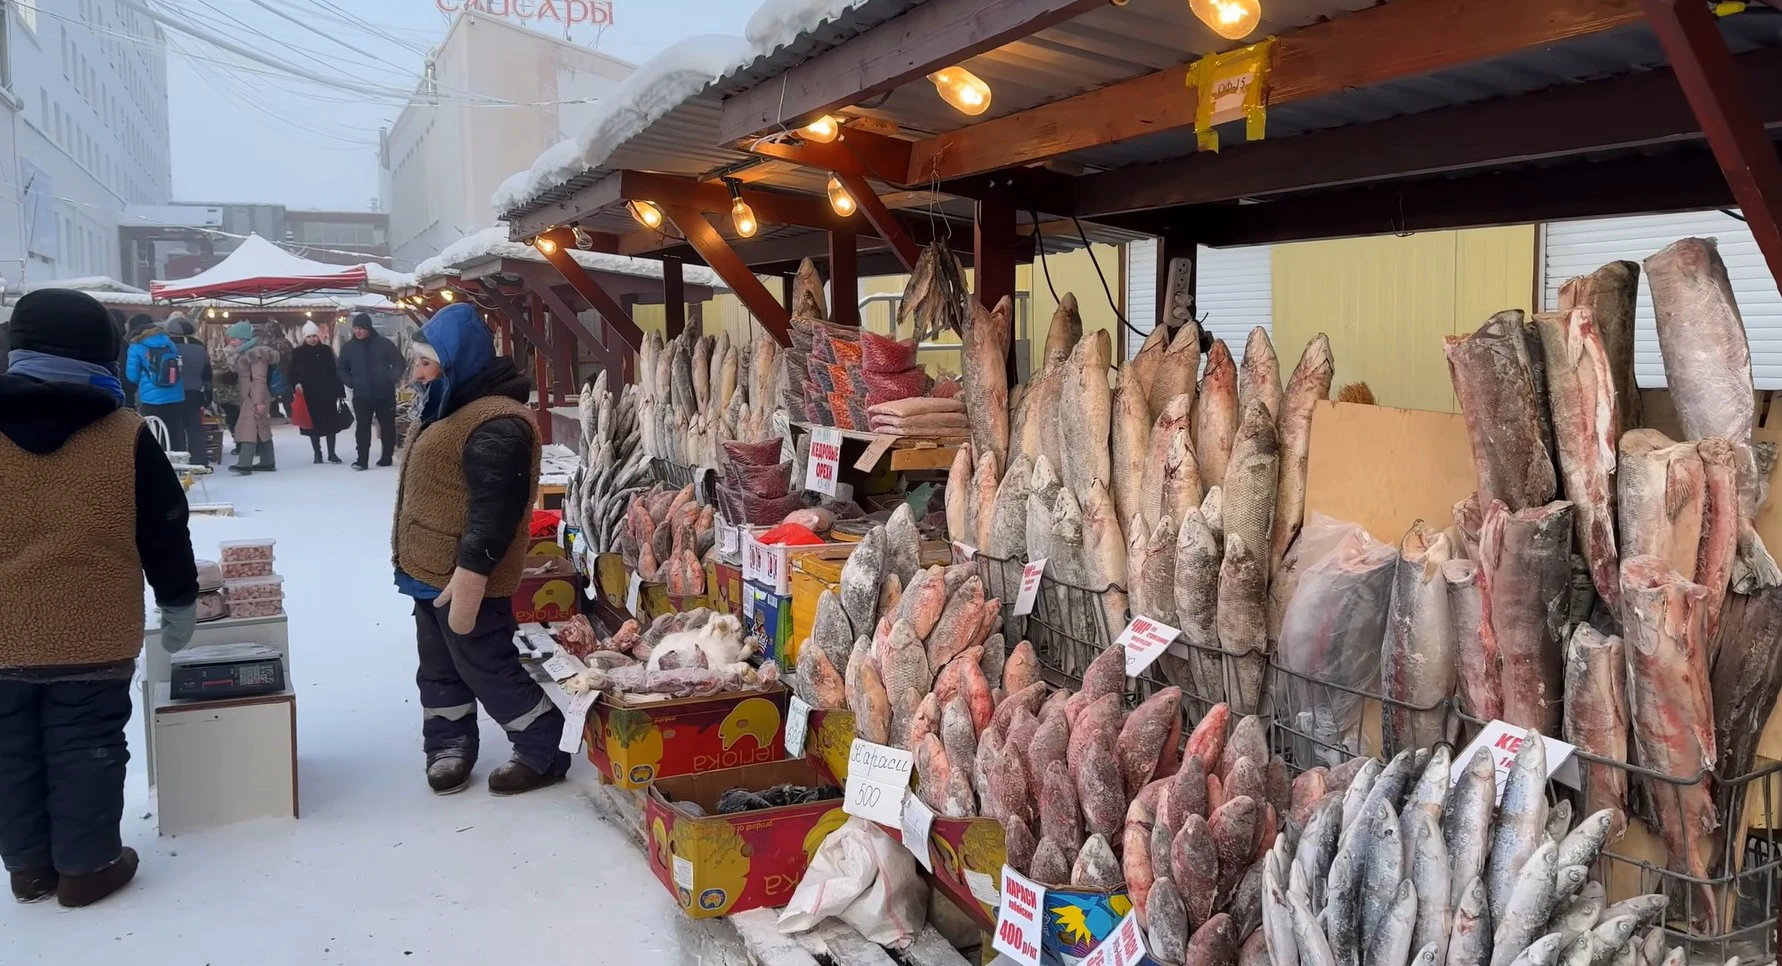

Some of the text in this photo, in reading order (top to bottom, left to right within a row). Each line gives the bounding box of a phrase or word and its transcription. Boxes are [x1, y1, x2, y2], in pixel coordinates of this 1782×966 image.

[1131, 618, 1153, 634] ЧИР
[1494, 733, 1524, 753] КЕ
[851, 743, 909, 776] Караси
[855, 782, 881, 808] 500
[746, 820, 773, 832] product
[1006, 876, 1037, 910] КАРАСИ
[999, 919, 1023, 951] 400
[1022, 937, 1038, 961] р/кг
